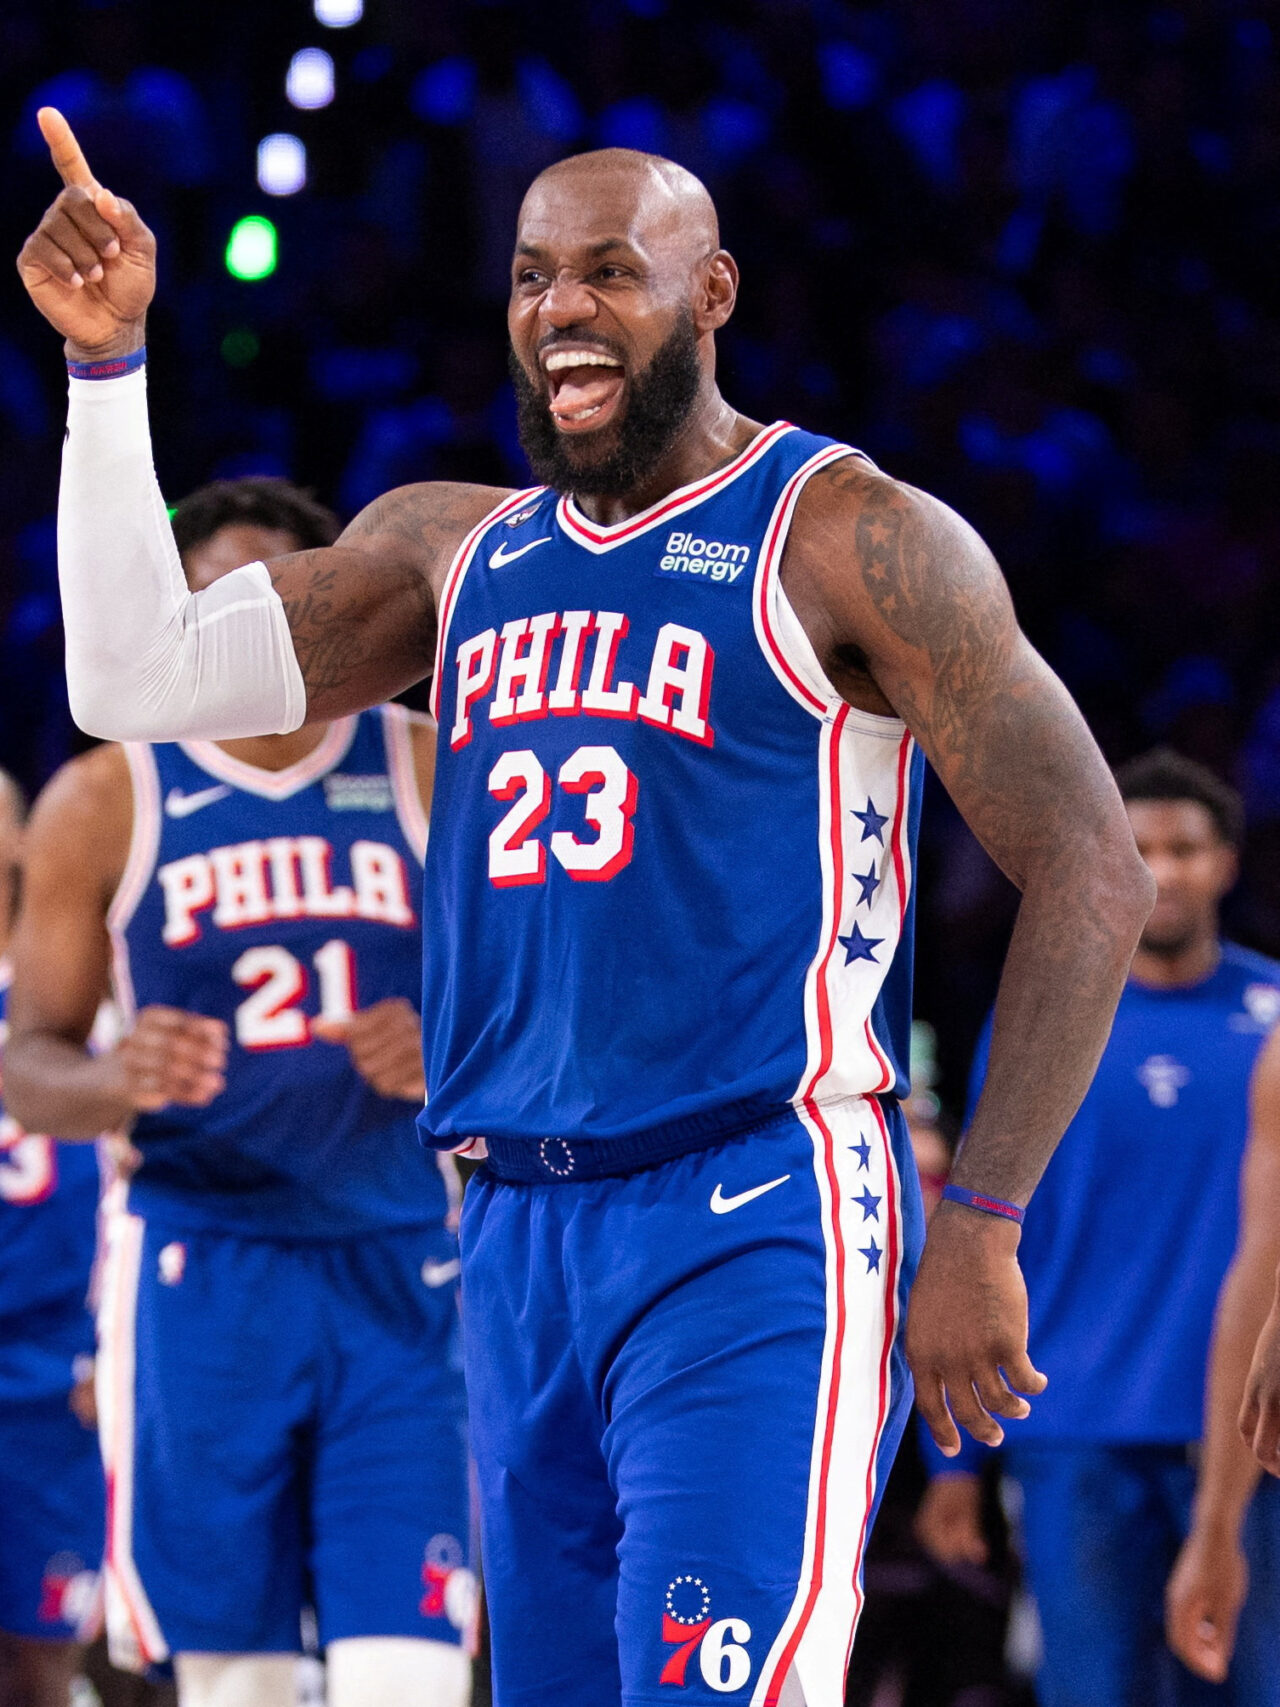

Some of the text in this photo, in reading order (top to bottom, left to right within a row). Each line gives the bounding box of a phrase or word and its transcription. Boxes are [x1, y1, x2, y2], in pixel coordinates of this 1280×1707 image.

[659, 555, 746, 583] energy
[665, 532, 751, 563] Bloom
[450, 610, 716, 753] PHILA
[487, 746, 640, 889] 23
[157, 834, 417, 950] PHILA
[230, 938, 358, 1053] 21
[659, 1611, 752, 1693] 76
